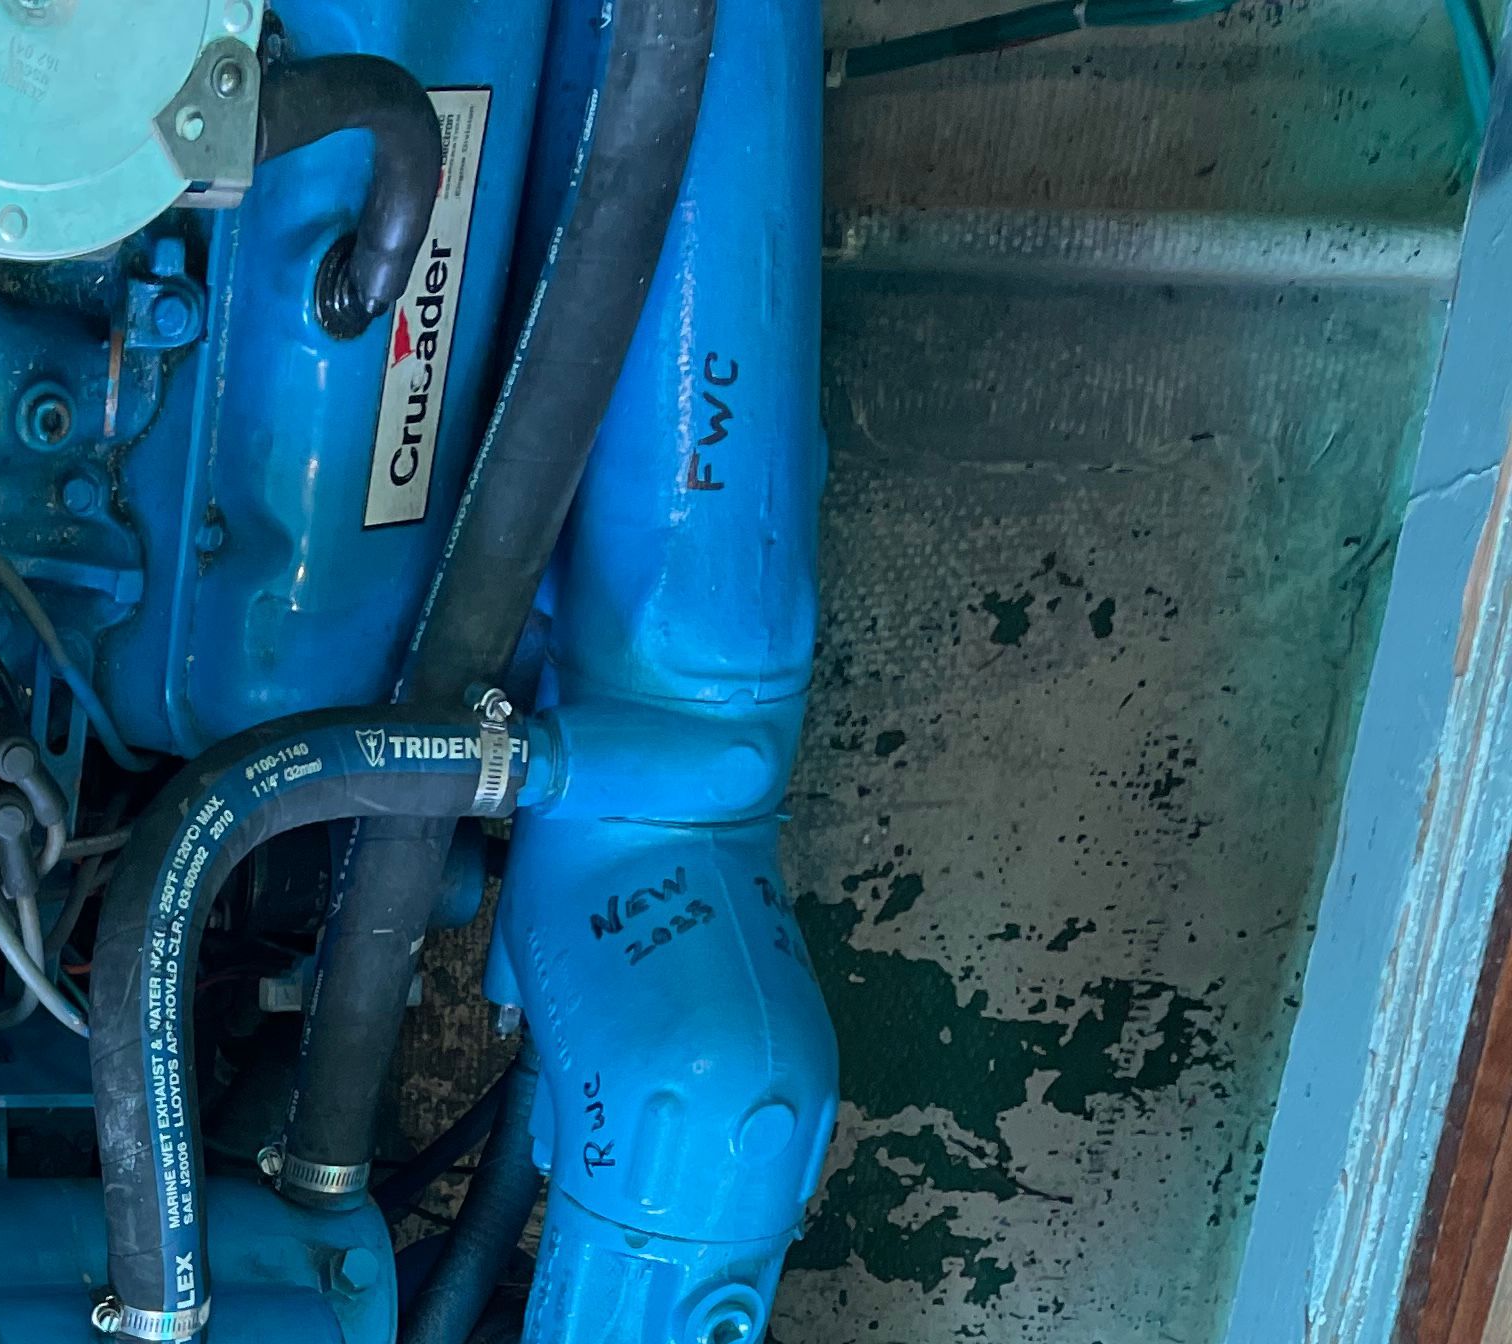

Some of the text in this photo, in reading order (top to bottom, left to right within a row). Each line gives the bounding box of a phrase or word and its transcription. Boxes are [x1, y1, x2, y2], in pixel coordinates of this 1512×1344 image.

[389, 238, 453, 487] Crusader
[687, 351, 739, 491] FWC
[283, 758, 323, 781] (32mm)
[196, 794, 225, 826] MAX.
[209, 809, 234, 840] 2010
[590, 865, 685, 940] NEW
[150, 1038, 163, 1050] &
[151, 1054, 170, 1129] EXHAUST
[168, 1058, 184, 1128] LLOYD'S
[159, 1133, 175, 1168] WET
[583, 1071, 616, 1178] RWC
[177, 1141, 191, 1188] J2006
[164, 1168, 181, 1229] MARINE
[182, 1192, 194, 1225] SAE
